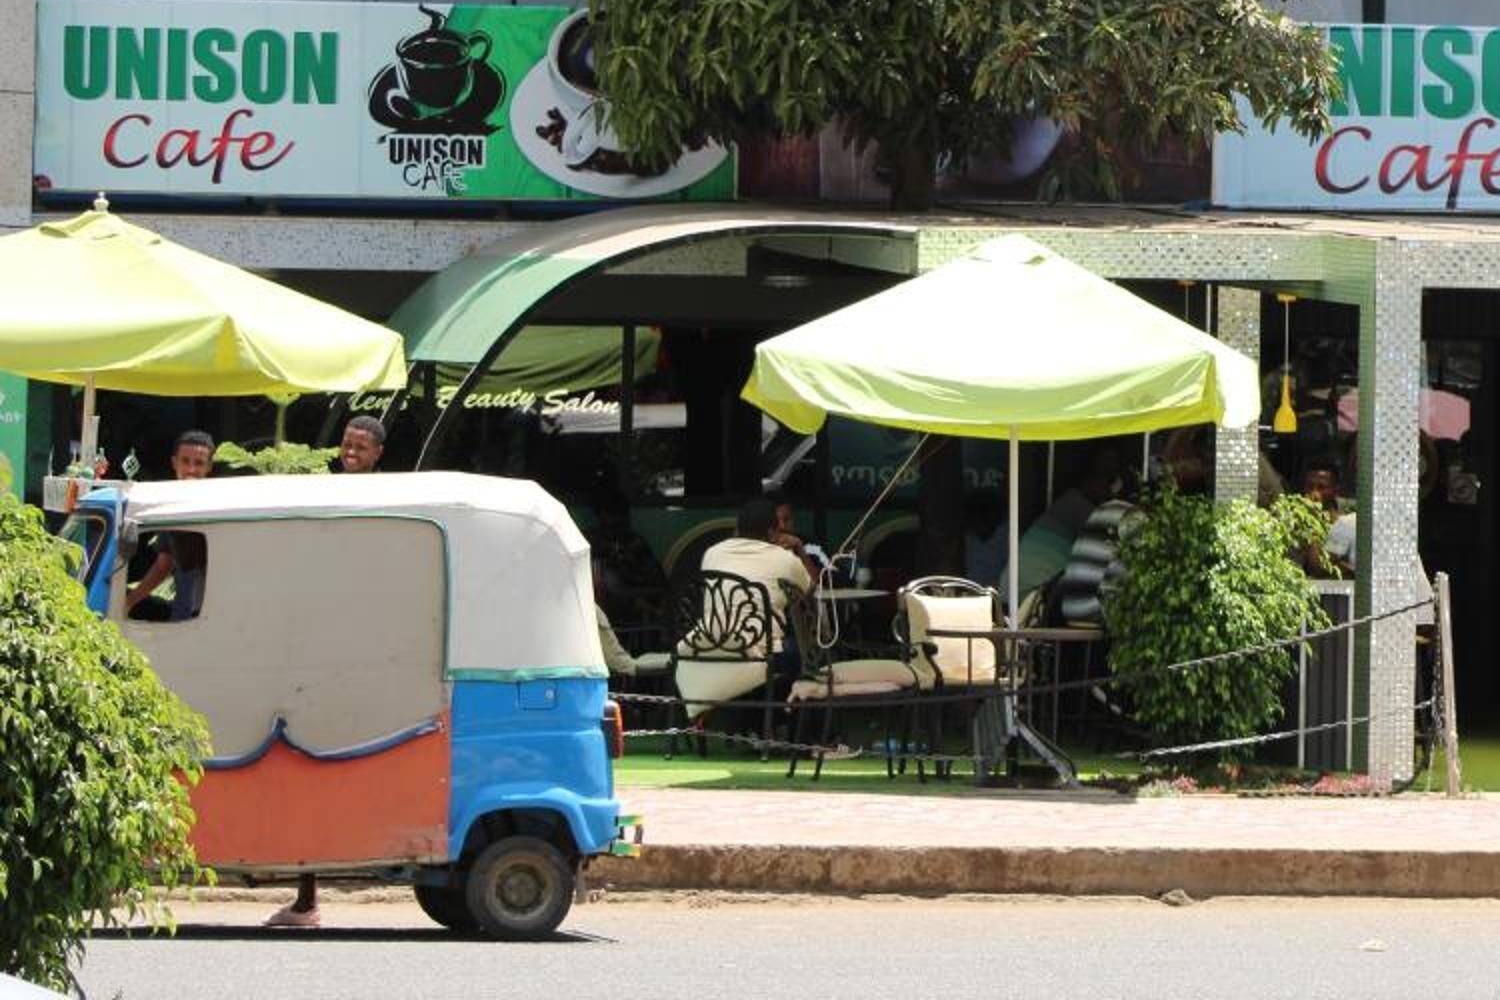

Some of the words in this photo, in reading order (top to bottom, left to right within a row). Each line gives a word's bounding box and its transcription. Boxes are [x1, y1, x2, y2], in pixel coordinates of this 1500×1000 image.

[63, 25, 339, 105] UNISON
[103, 109, 295, 185] Cafe
[388, 136, 484, 165] UNISON
[437, 385, 537, 412] Beauty
[541, 389, 620, 416] Salon
